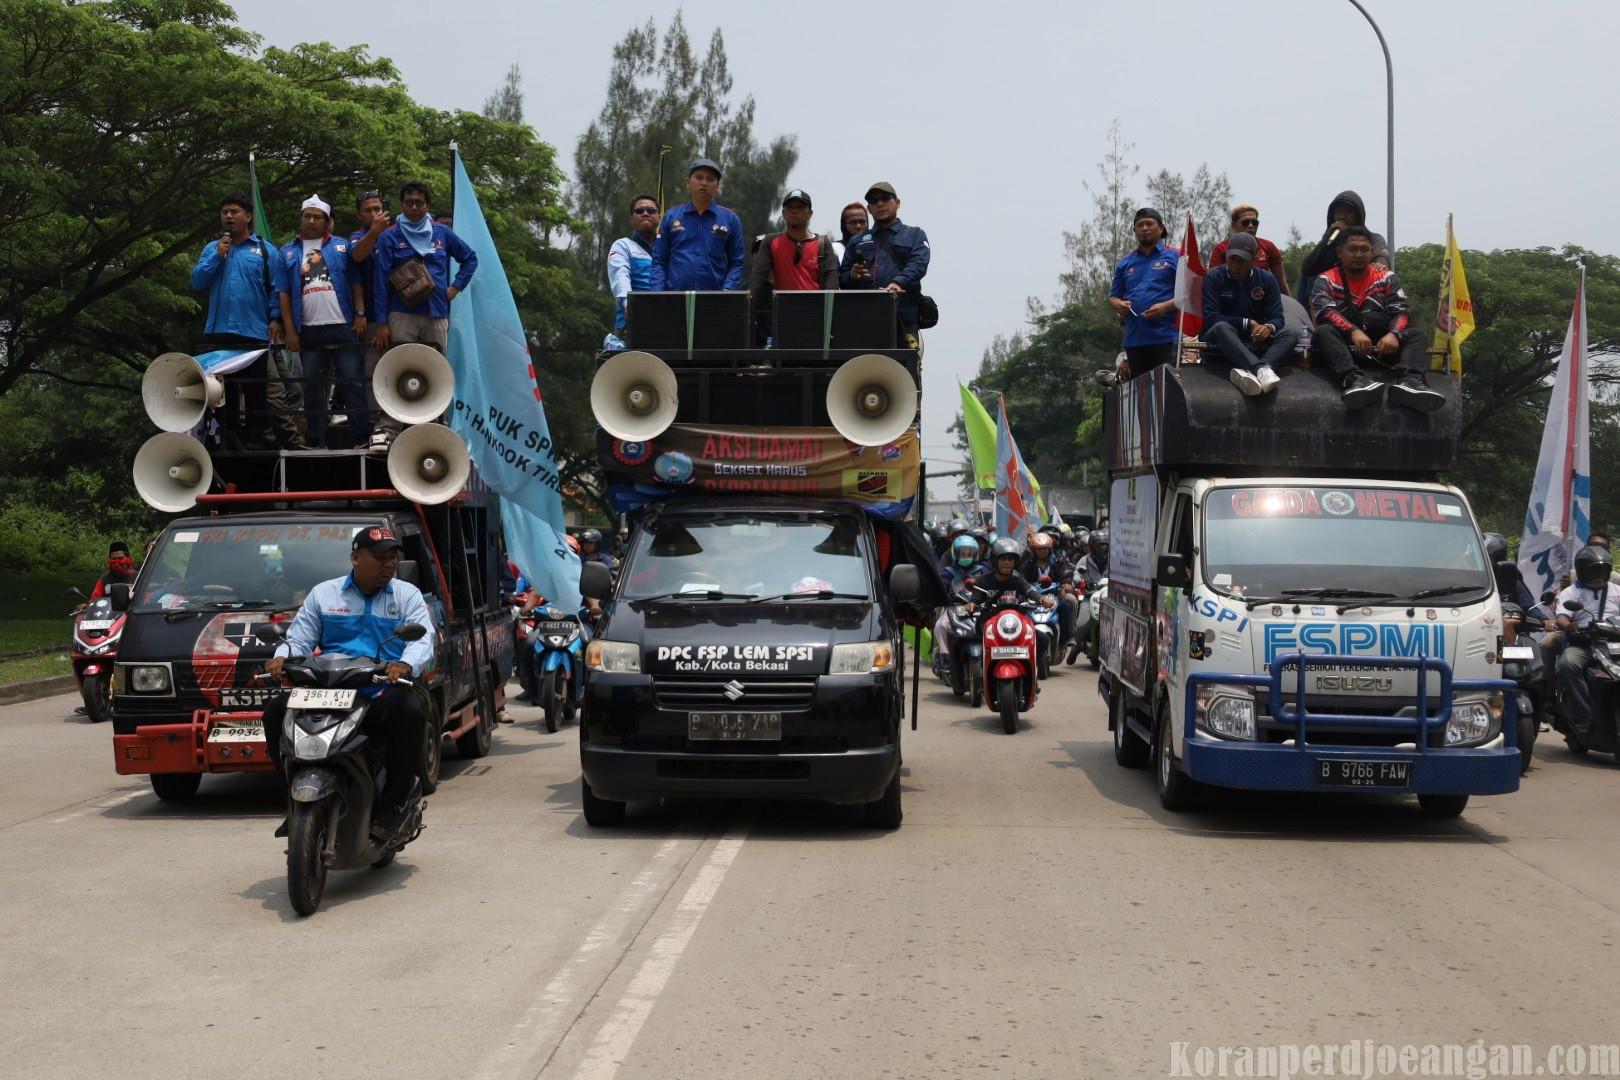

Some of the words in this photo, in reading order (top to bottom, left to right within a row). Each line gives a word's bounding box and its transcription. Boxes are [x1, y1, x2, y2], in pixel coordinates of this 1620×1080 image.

[456, 400, 471, 420] PT
[489, 406, 525, 441] PUK
[702, 434, 752, 460] AKSI
[757, 434, 822, 461] DAMAI
[1354, 491, 1446, 521] METAL
[232, 526, 284, 542] KSPSI
[316, 525, 352, 541] PAS
[1191, 594, 1250, 633] KSPI
[1264, 623, 1445, 663] FSPMI
[658, 646, 692, 660] DPC
[698, 646, 728, 659] FSP
[734, 645, 770, 659] LEM
[776, 646, 813, 660] SPSI
[675, 660, 741, 671] Kab./Kota
[745, 661, 789, 671] Bekasi
[1316, 674, 1393, 691] ISUZU
[291, 689, 298, 698] B
[304, 690, 328, 698] 3961
[212, 728, 221, 738] B
[1322, 761, 1330, 777] B
[1341, 762, 1374, 778] 9766
[1380, 763, 1407, 779] FAW
